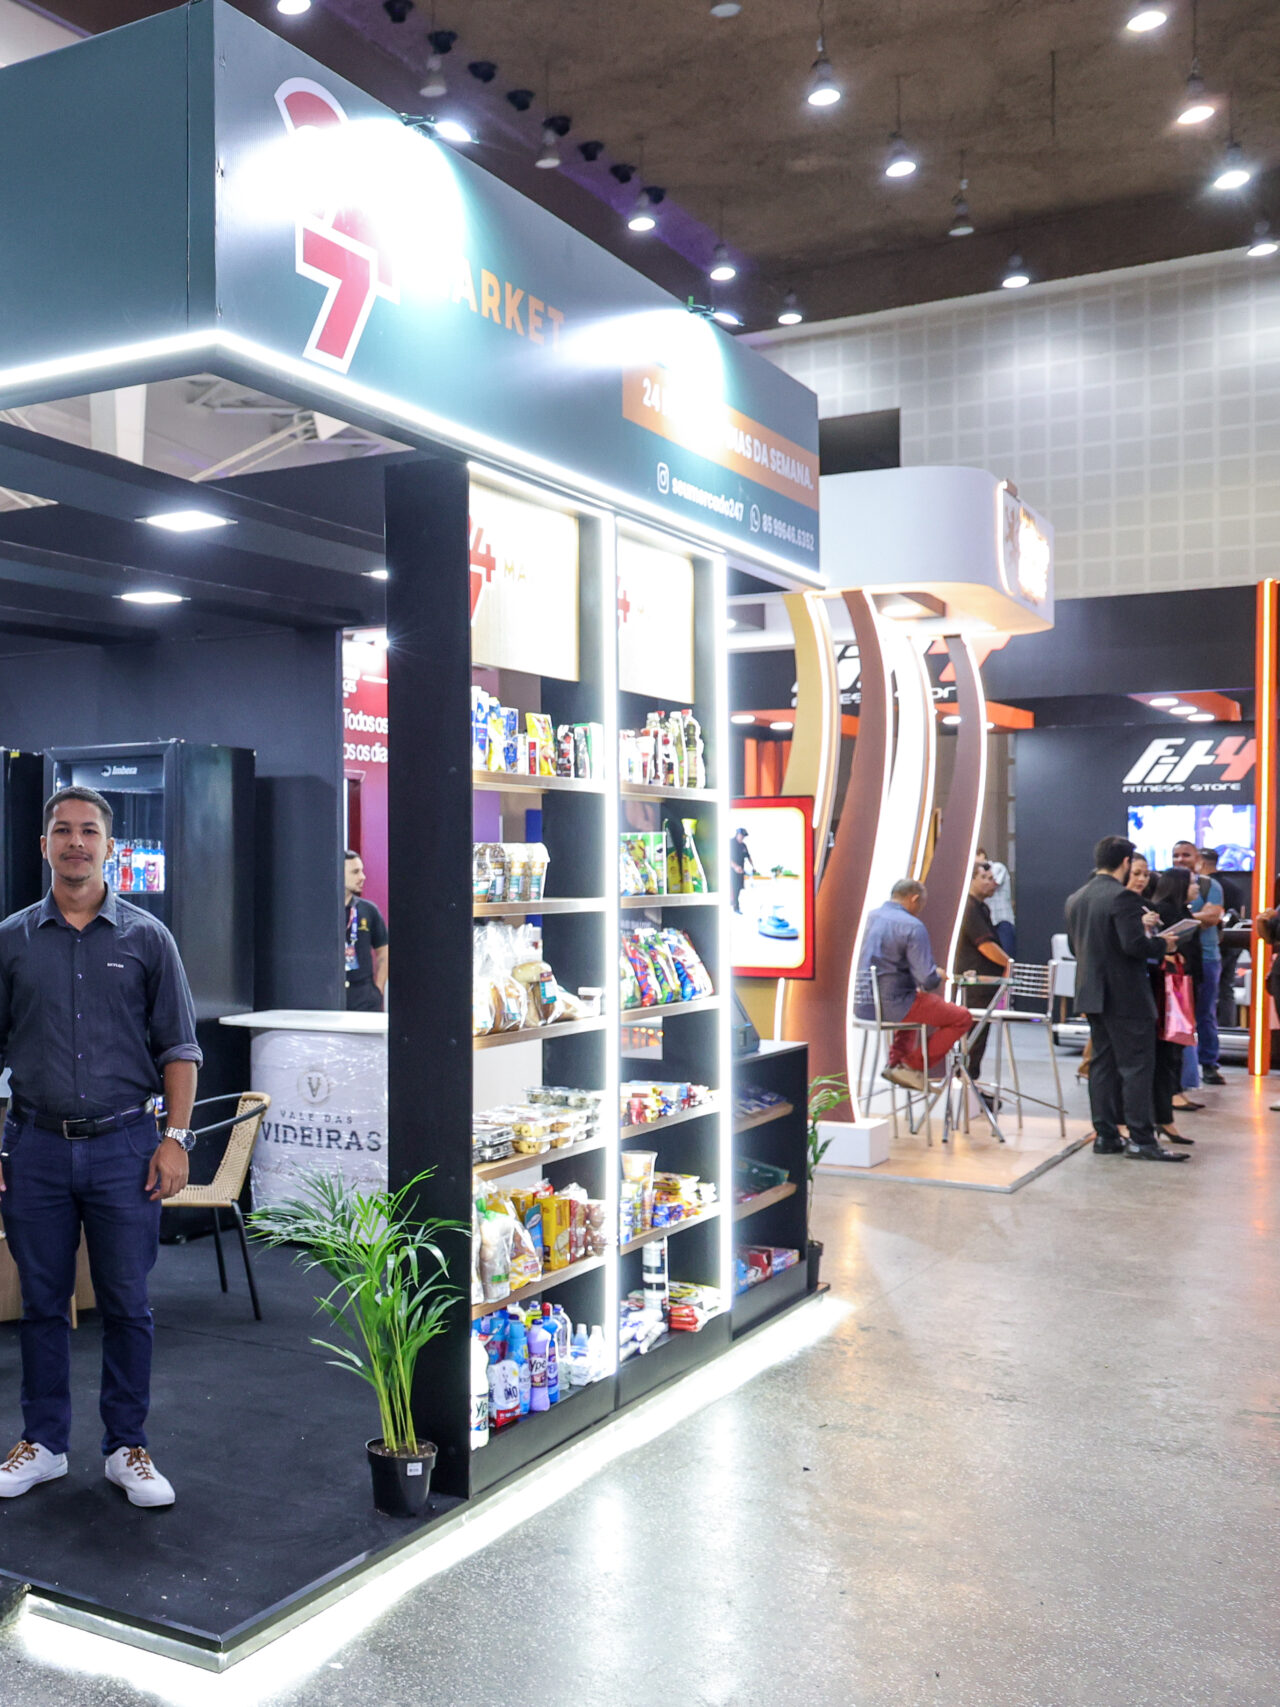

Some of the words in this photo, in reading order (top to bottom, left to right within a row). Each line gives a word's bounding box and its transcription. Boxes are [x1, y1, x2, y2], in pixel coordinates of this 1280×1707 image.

[453, 256, 565, 353] ARKET
[753, 439, 769, 468] DA
[343, 707, 375, 733] Todos
[370, 742, 388, 763] dia
[280, 1110, 315, 1122] VALE
[324, 1114, 353, 1125] DAS
[261, 1121, 382, 1152] VIDEIRAS
